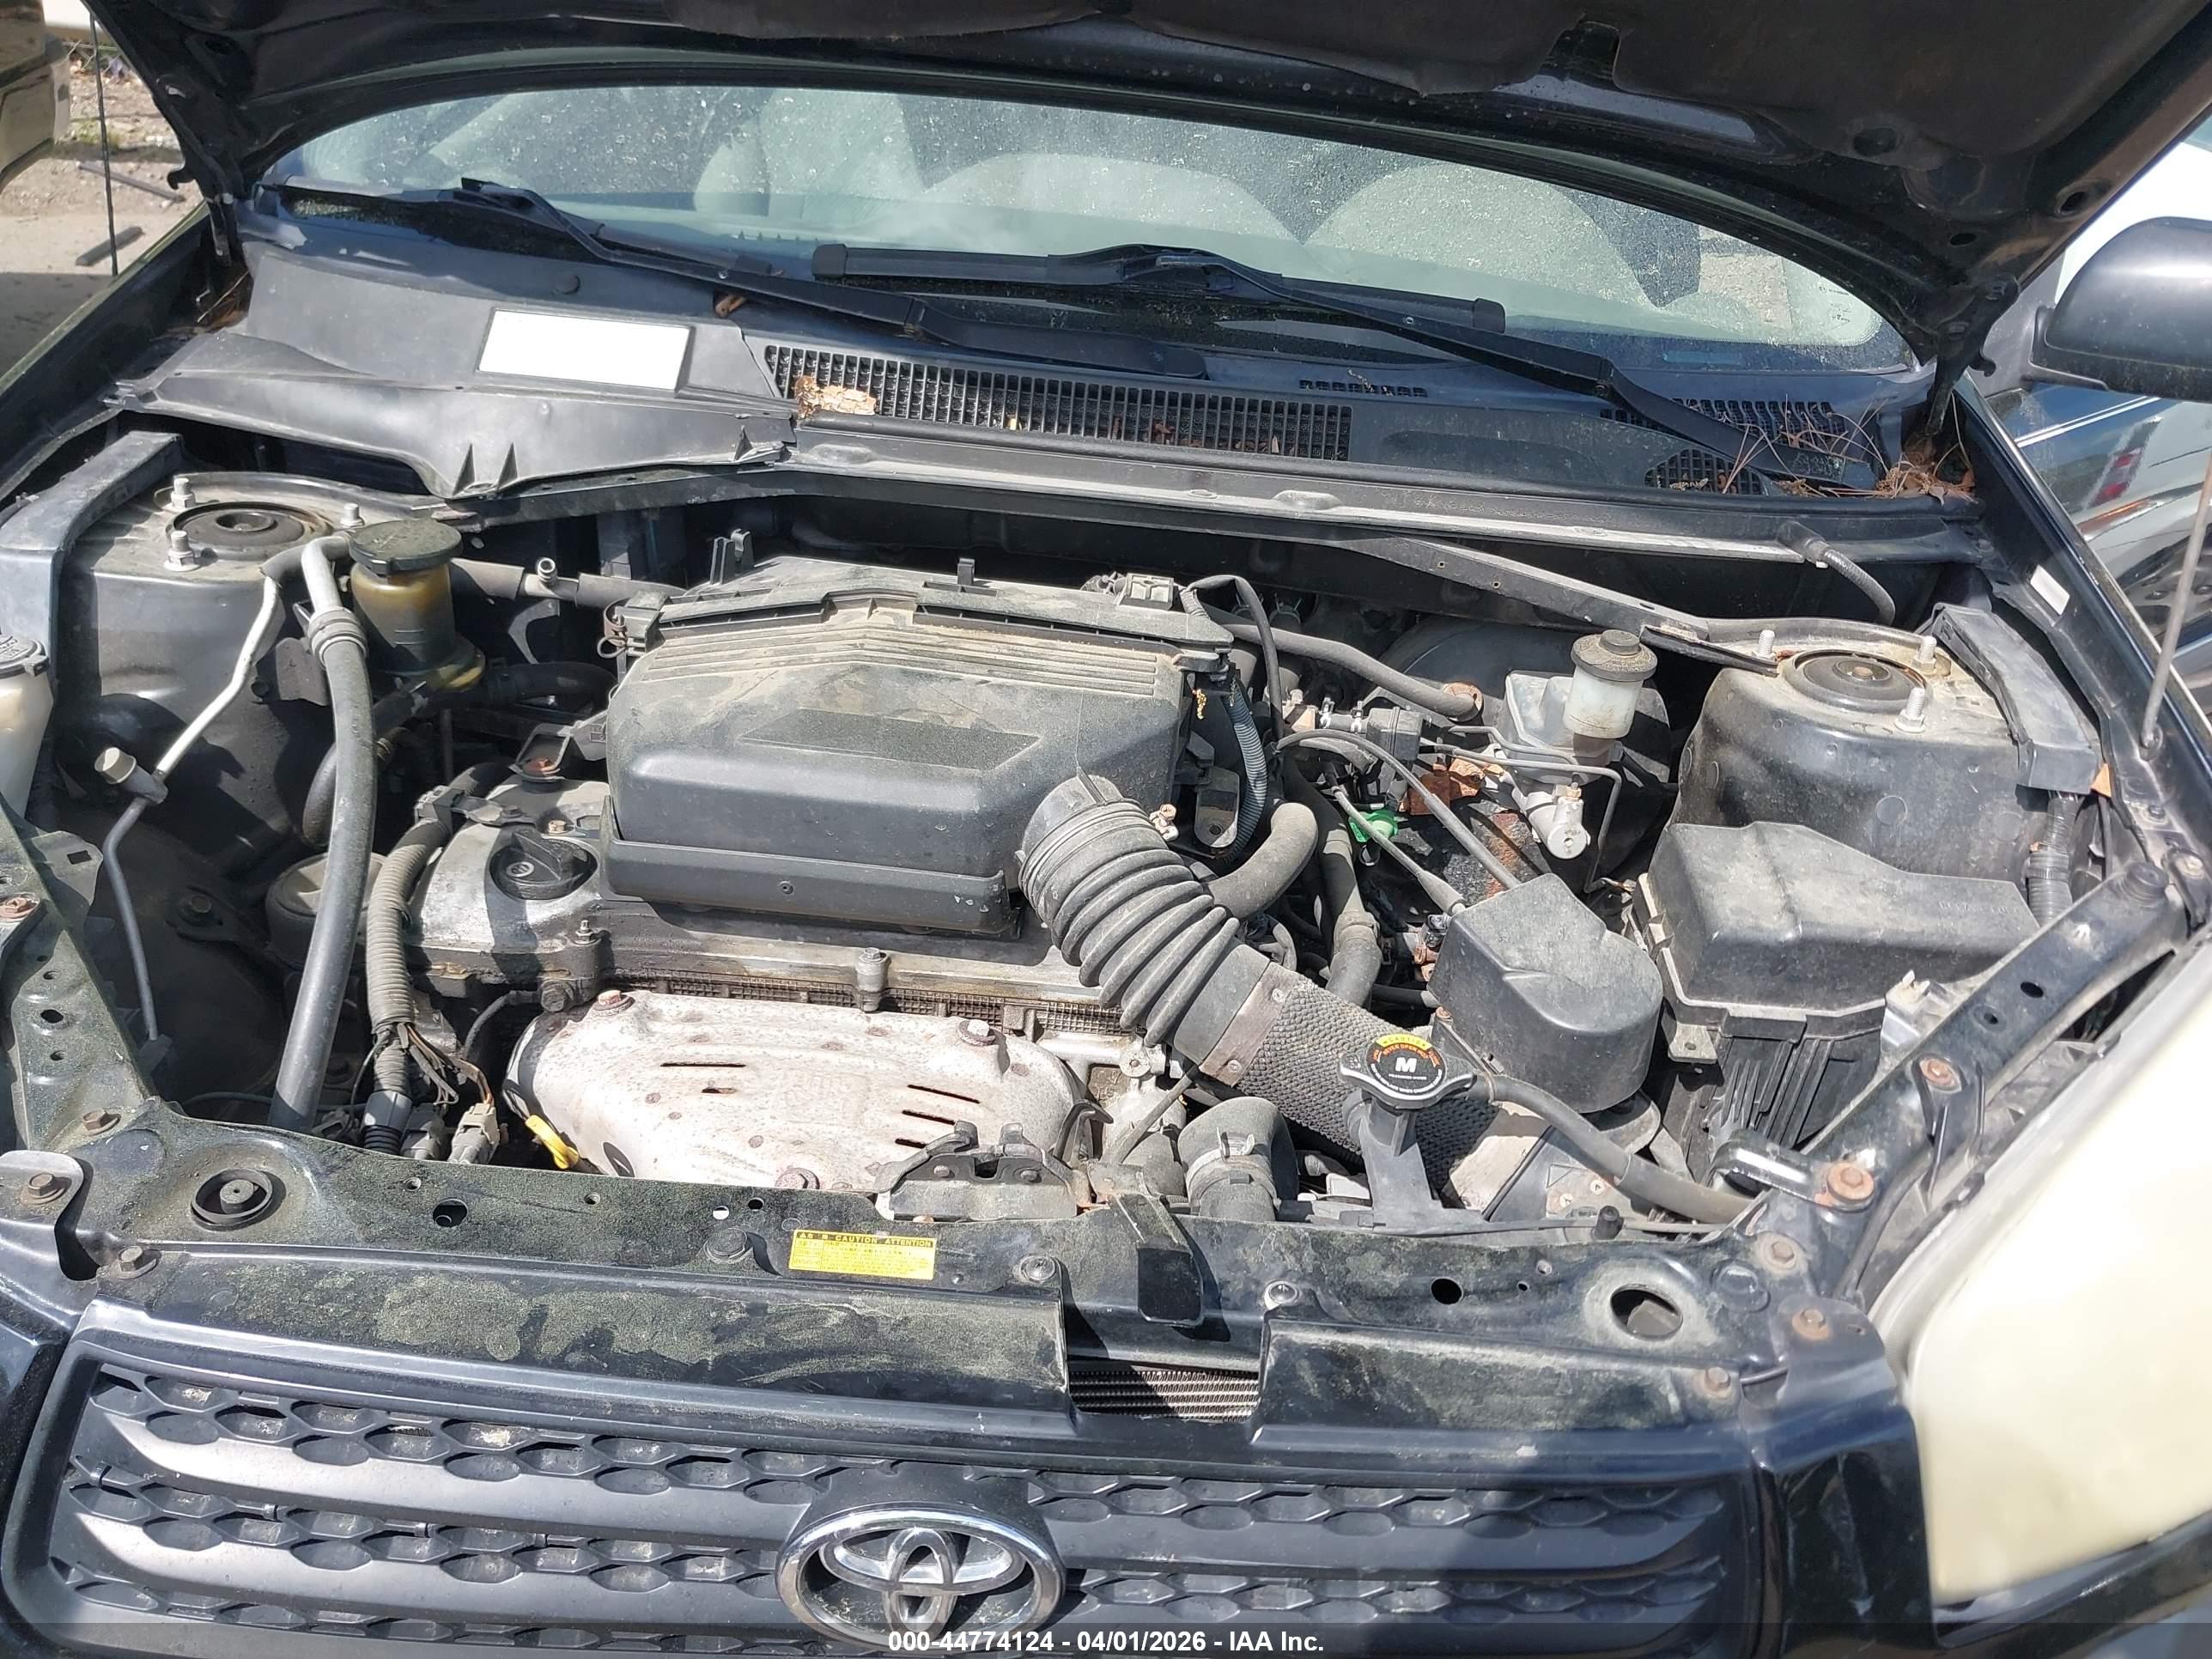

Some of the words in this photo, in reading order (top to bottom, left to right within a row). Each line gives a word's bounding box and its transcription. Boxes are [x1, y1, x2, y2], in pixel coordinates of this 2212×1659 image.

[1395, 1057, 1418, 1073] M
[836, 1235, 878, 1243] CAUTION
[885, 1238, 932, 1247] ATTENTION
